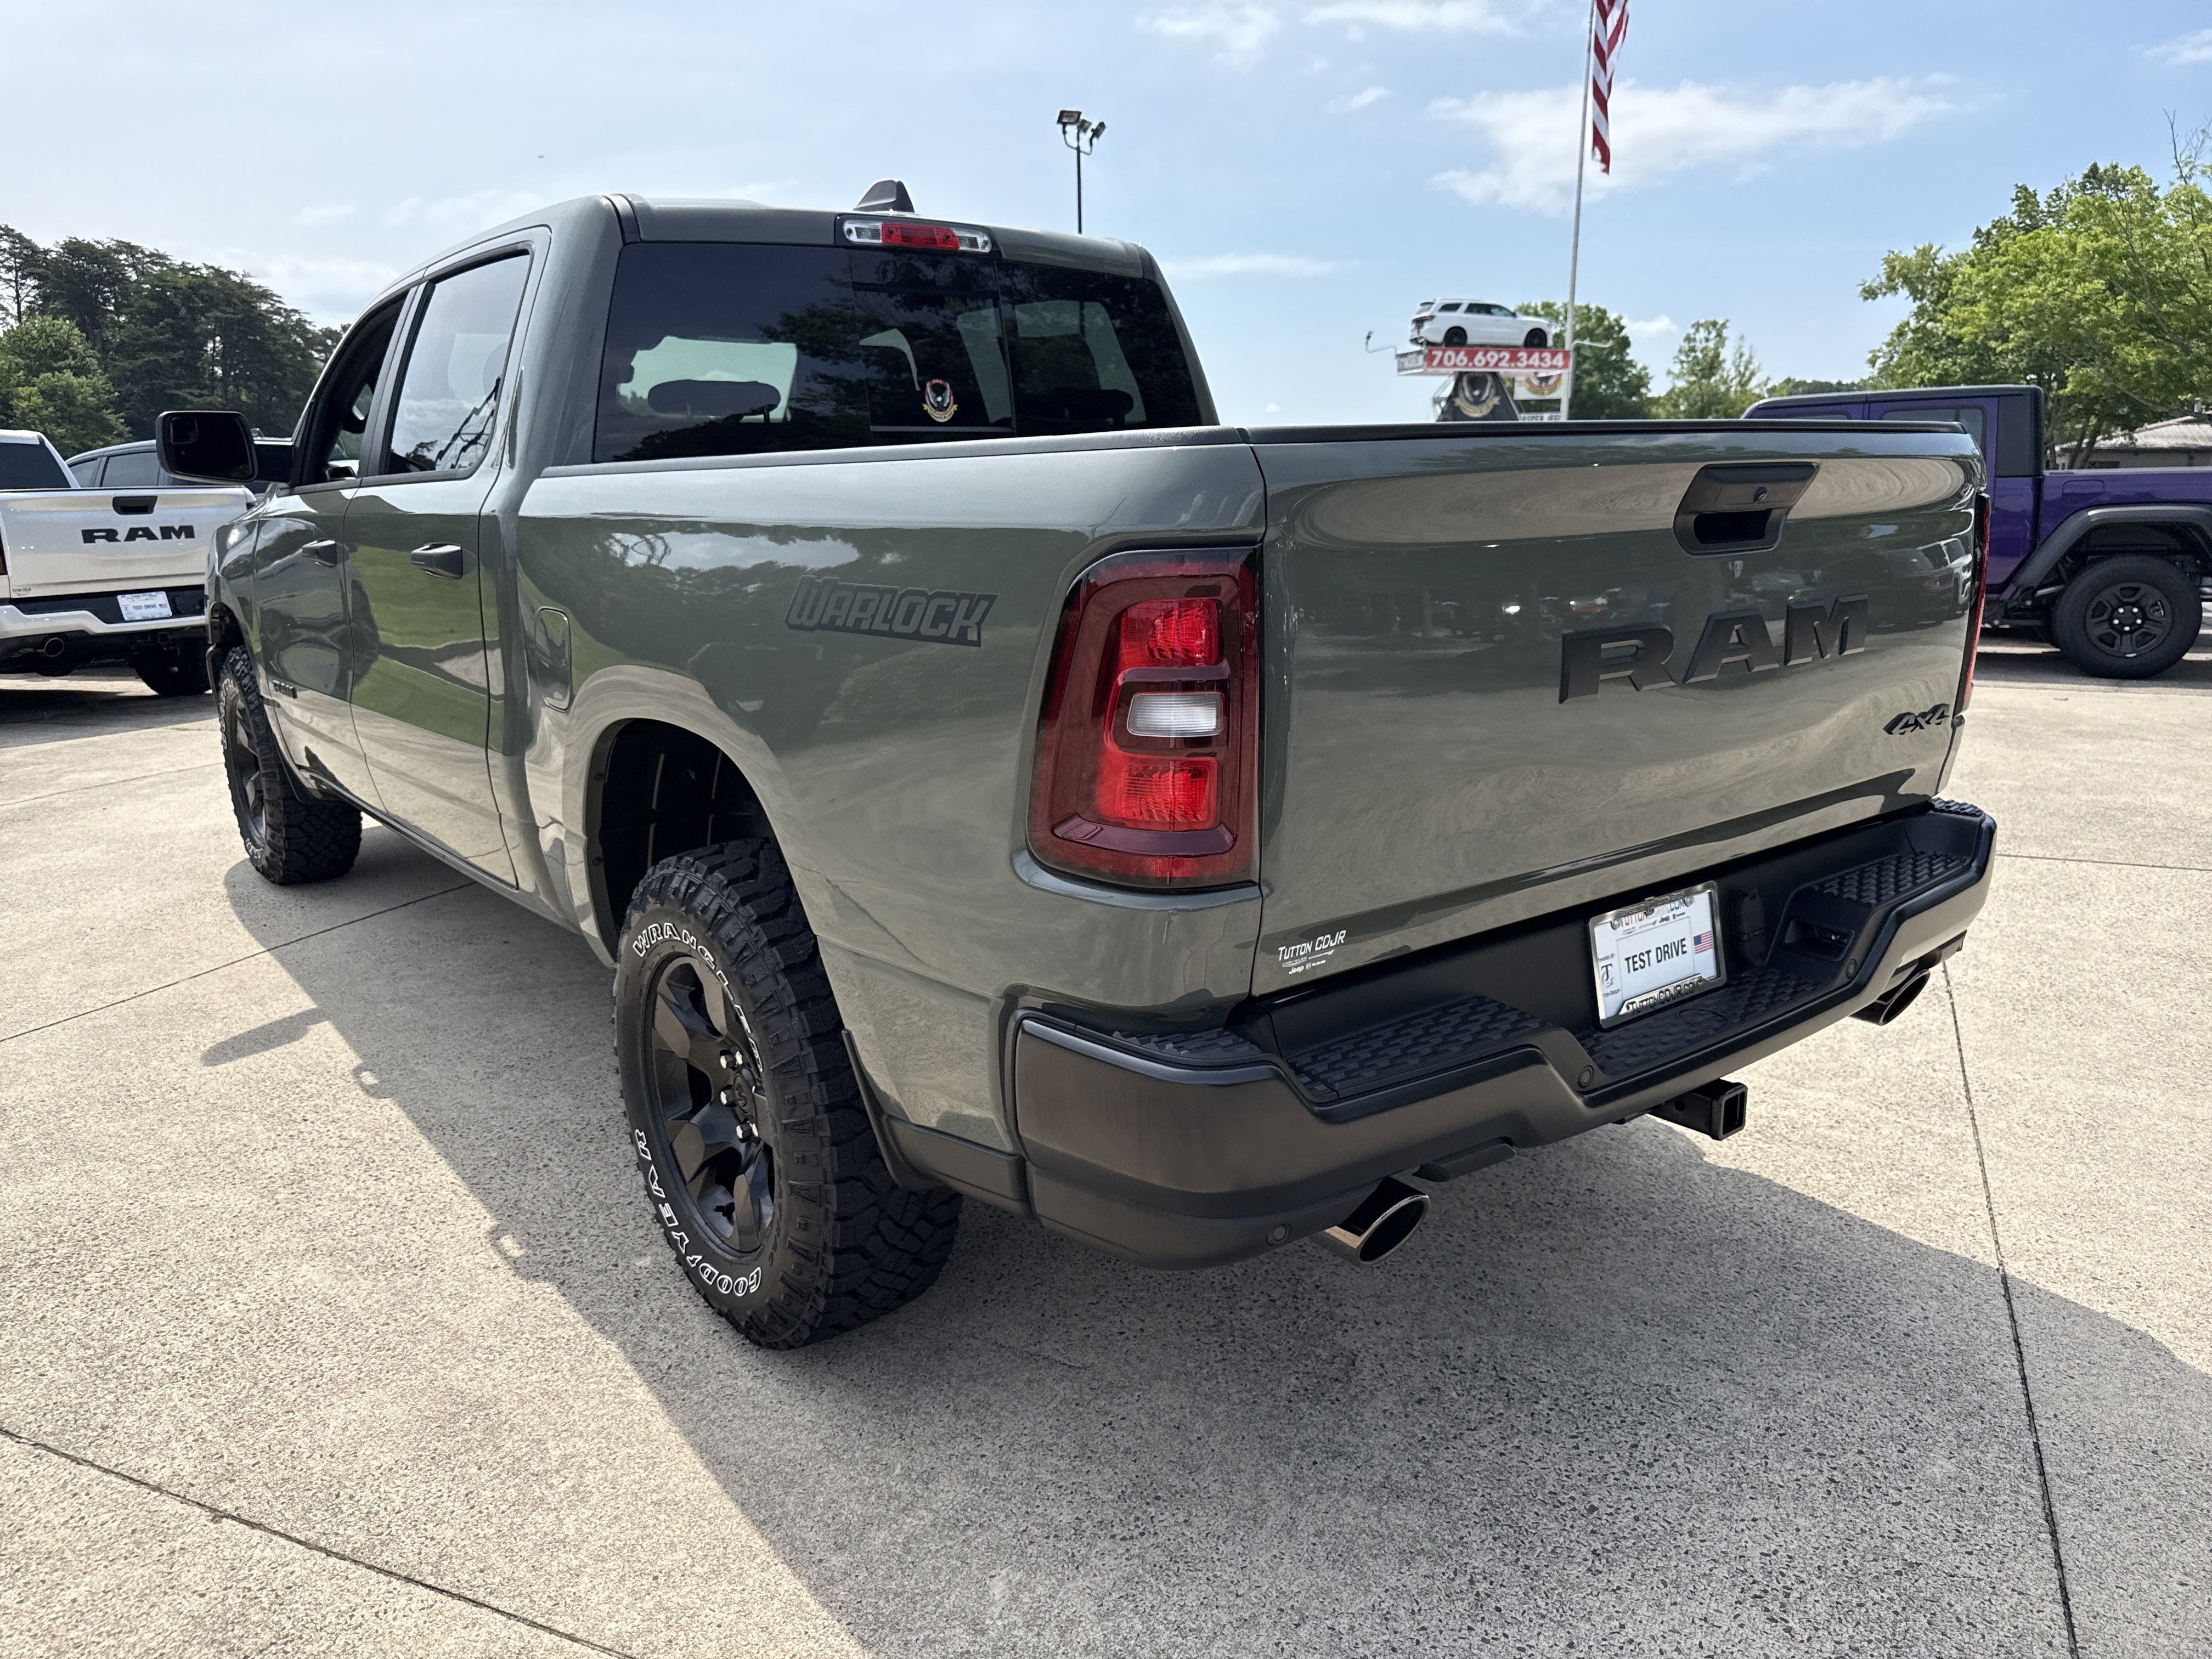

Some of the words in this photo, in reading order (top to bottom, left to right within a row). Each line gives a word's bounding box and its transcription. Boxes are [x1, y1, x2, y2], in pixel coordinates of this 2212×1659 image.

[1431, 349, 1564, 368] 706.692.3434
[81, 524, 196, 544] RAM
[785, 575, 997, 647] WARLOCK
[1558, 593, 1869, 705] RAM
[1278, 940, 1313, 961] TUTTON
[1315, 929, 1347, 951] CDJR
[1624, 949, 1652, 974] TEST
[1655, 938, 1688, 964] DRIVE
[1289, 966, 1305, 974] Jeep
[635, 1128, 761, 1296] GOODYEAR
